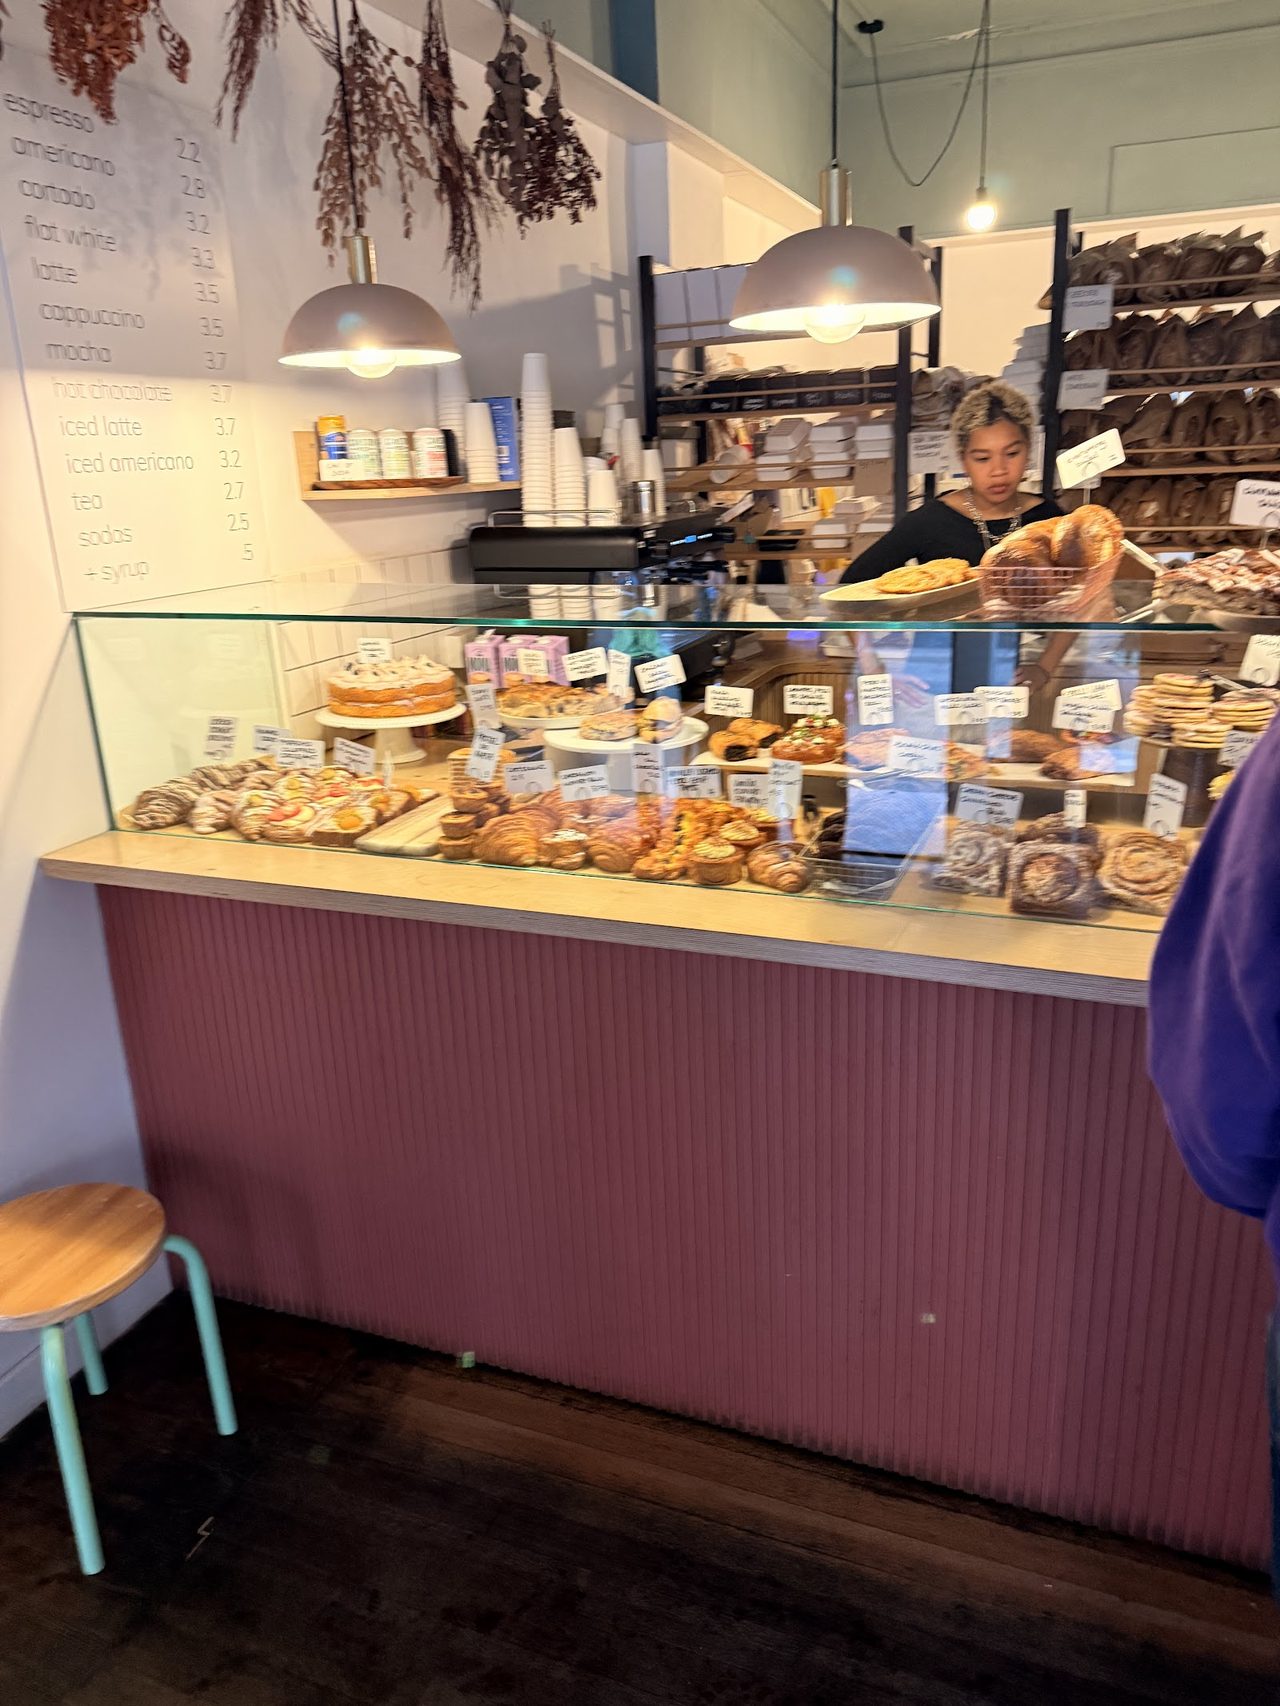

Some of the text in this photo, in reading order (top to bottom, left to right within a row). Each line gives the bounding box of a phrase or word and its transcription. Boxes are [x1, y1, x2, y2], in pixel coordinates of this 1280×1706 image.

[4, 93, 95, 133] espresso
[12, 137, 115, 176] americano
[19, 180, 95, 209] cortado
[24, 214, 60, 242] flat
[64, 226, 117, 252] white
[31, 256, 78, 284] latte
[40, 303, 145, 329] cappuccino
[46, 341, 112, 363] mocha
[52, 376, 88, 399] hot
[89, 378, 173, 402] chocolate
[59, 415, 236, 436] iced latte 3.7
[65, 450, 242, 474] iced americano 3.2
[71, 481, 244, 511] tea 2.7
[79, 512, 250, 547] sodas 2.5
[101, 561, 149, 584] syrup
